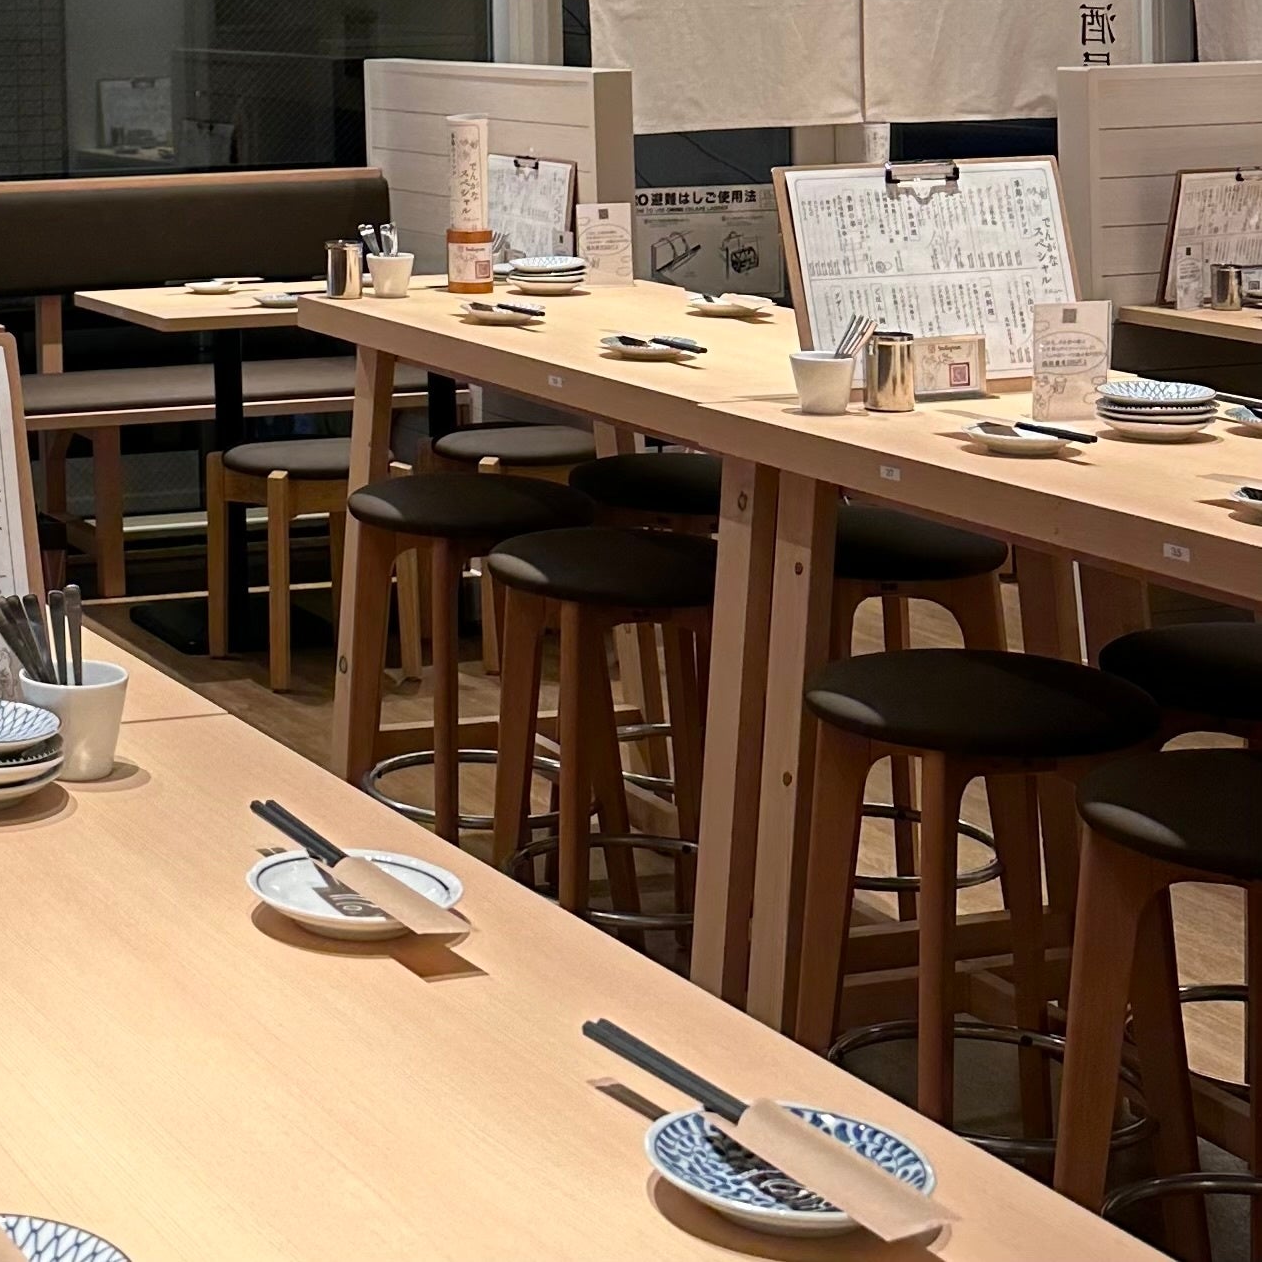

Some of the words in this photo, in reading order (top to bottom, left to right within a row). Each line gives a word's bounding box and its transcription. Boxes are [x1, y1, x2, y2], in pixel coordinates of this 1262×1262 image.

[650, 189, 757, 206] 避難はしご使用法
[1034, 227, 1051, 284] スペシャル
[1042, 217, 1059, 267] でんがな
